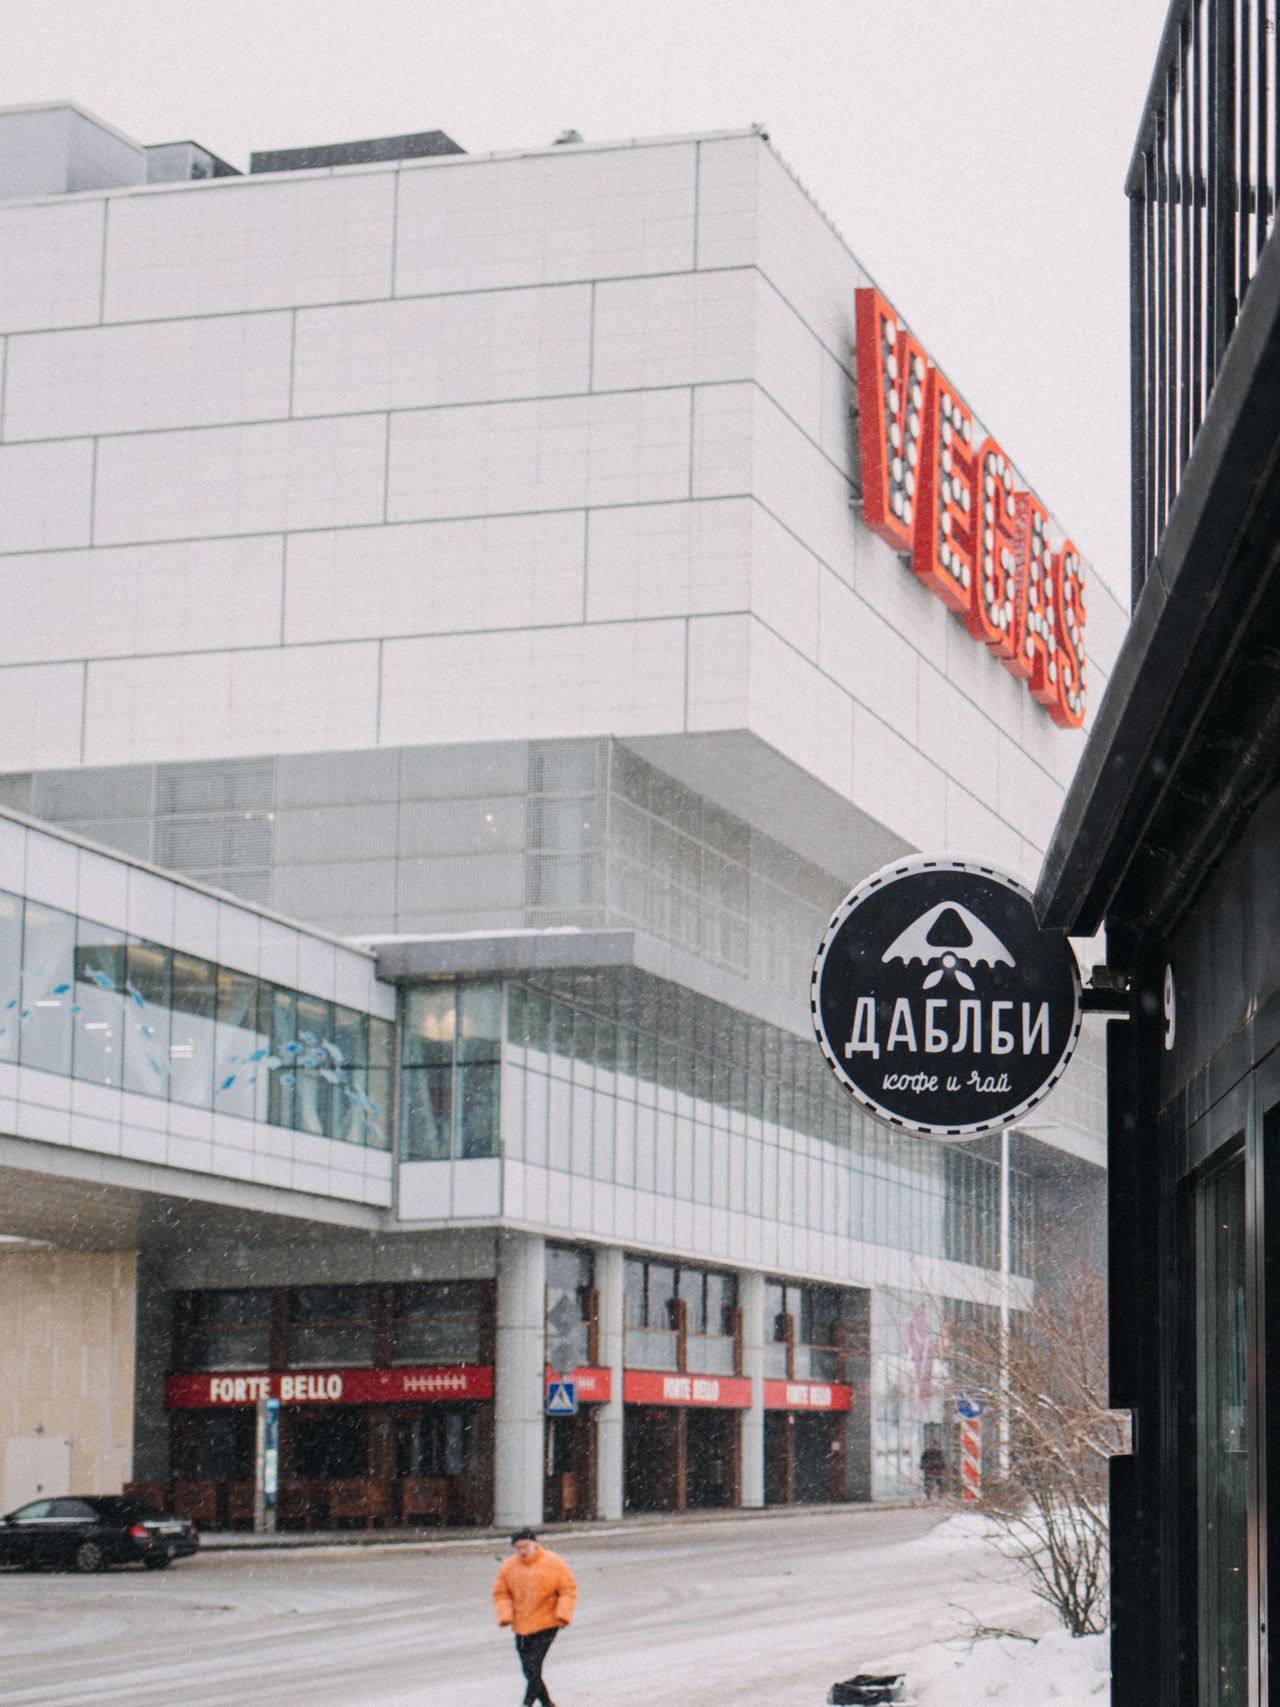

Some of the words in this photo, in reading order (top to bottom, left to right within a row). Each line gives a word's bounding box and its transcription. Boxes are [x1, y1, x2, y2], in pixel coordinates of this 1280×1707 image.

[855, 288, 1087, 729] VEGAS
[845, 997, 1049, 1059] ДАБЛБИ
[882, 1072, 939, 1094] кофе
[946, 1074, 961, 1091] и
[966, 1070, 1012, 1093] чай
[210, 1377, 270, 1402] FORTE
[280, 1374, 343, 1400] BELLO
